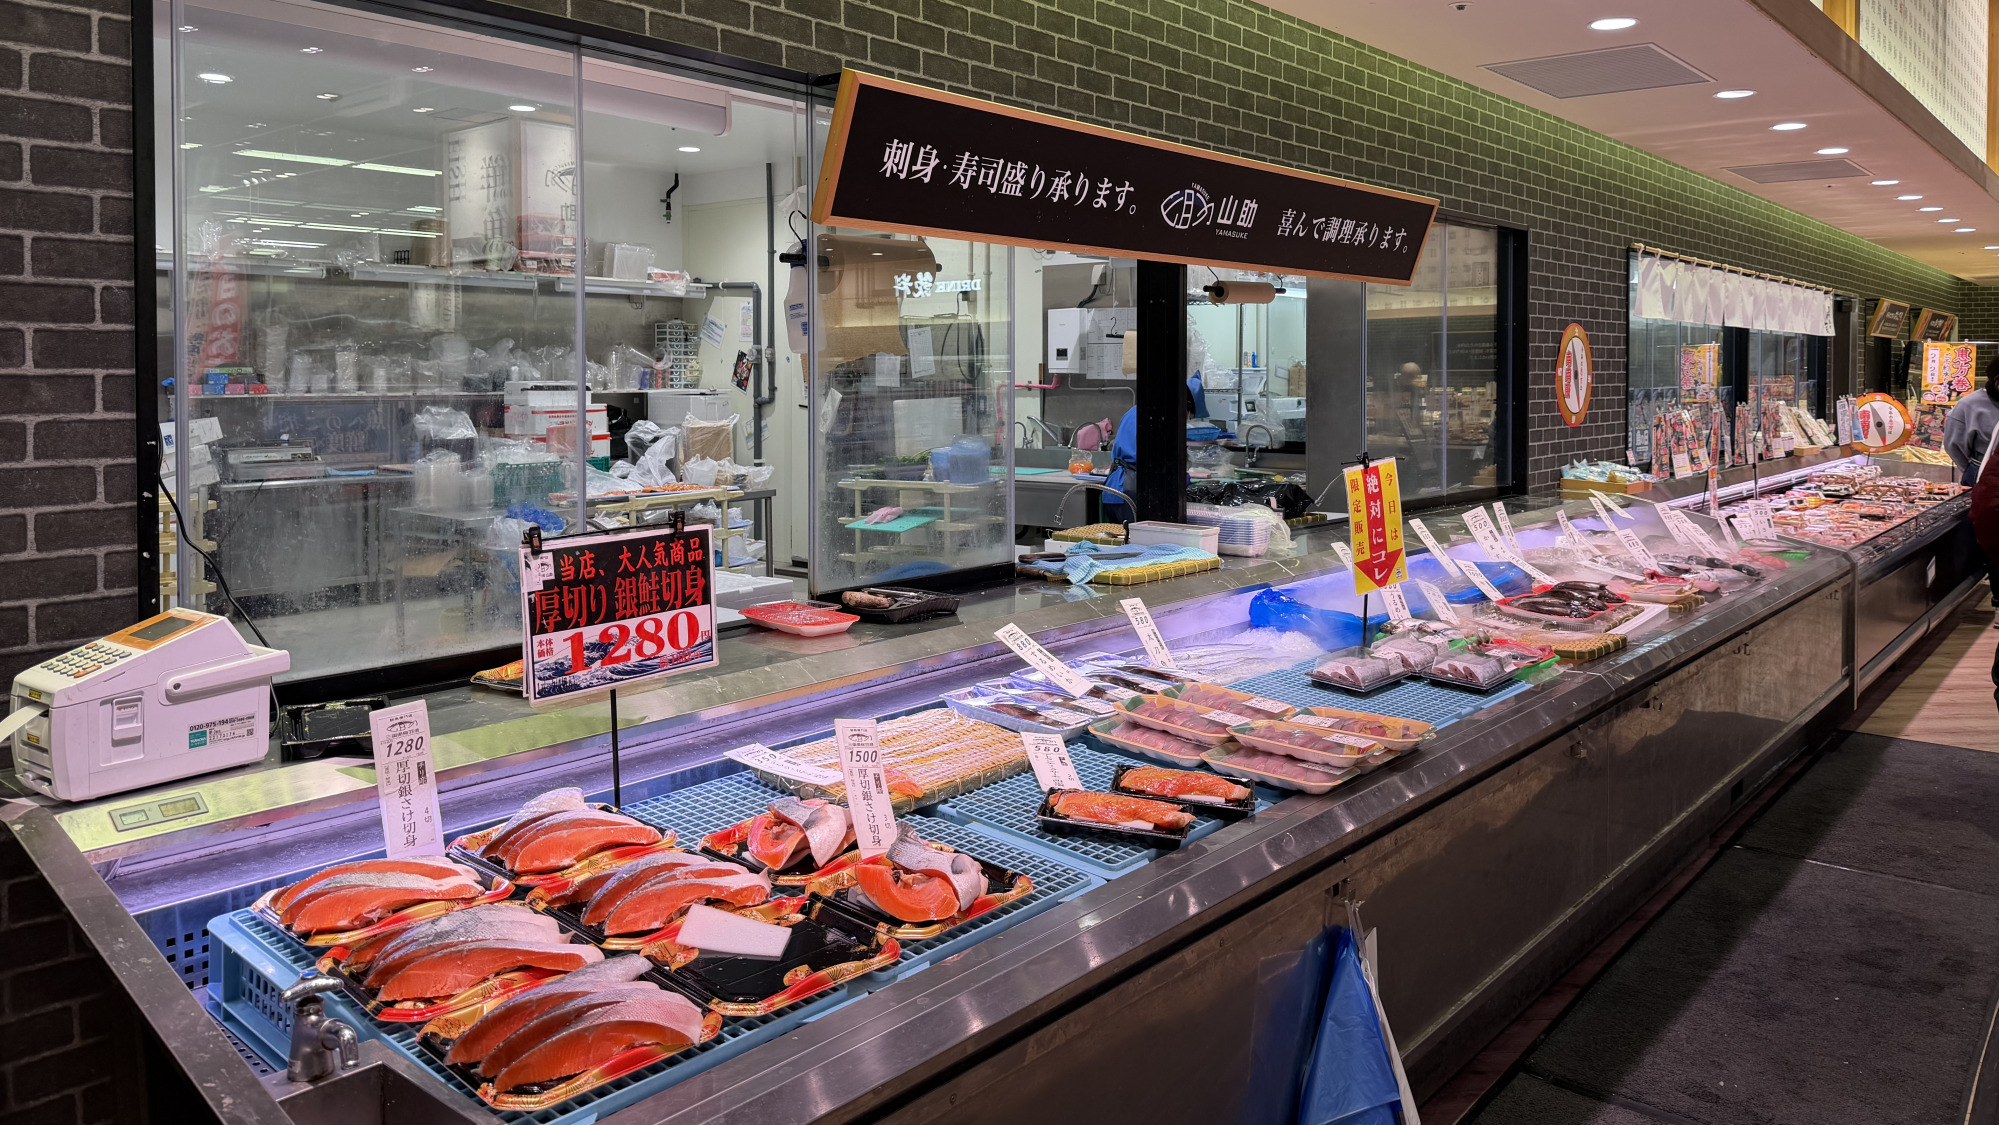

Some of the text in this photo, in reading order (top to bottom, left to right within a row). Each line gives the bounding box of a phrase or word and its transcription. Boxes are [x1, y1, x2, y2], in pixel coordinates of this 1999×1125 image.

[879, 138, 1137, 215] 刺身・寿司盛り承ります。
[1216, 194, 1259, 228] 山助
[1215, 228, 1248, 240] YAMASUKE
[1276, 208, 1408, 254] 喜んで調理承ります。
[1350, 478, 1365, 557] 限定販売
[1384, 472, 1399, 542] 今日は
[1365, 473, 1388, 580] 絶対にコレ
[1473, 520, 1488, 532] 500
[559, 537, 703, 582] 当店、 大人気商品
[535, 564, 705, 634] 厚切り 銀鮭切身
[1135, 615, 1149, 626] 580
[1016, 637, 1031, 650] 880
[1030, 651, 1073, 685] するめいか
[189, 718, 229, 732] 0120-975-194
[386, 735, 424, 758] 1280
[849, 750, 878, 763] 1500
[1034, 745, 1060, 753] 580
[396, 759, 418, 848] 厚切銀さけ切身
[424, 806, 432, 824] 4切
[857, 768, 882, 847] 厚切銀さけ切身
